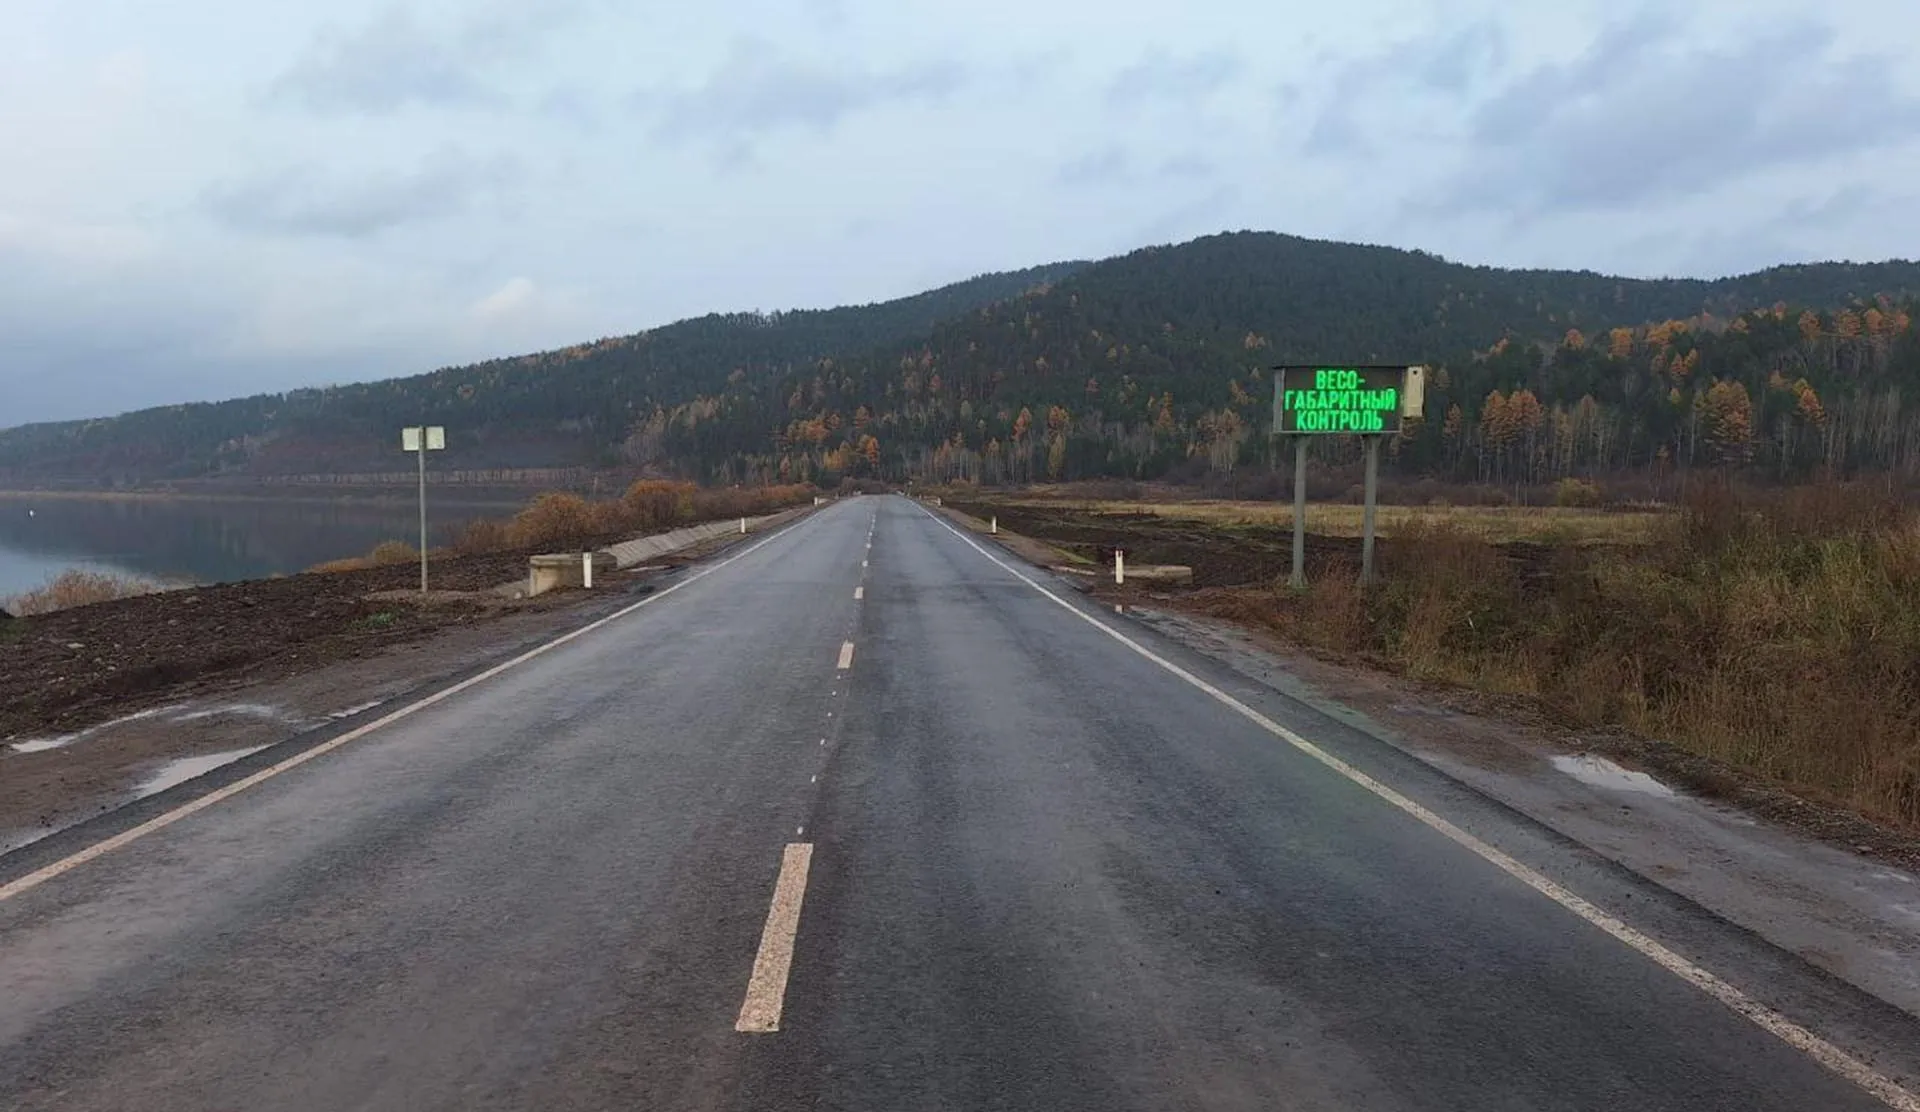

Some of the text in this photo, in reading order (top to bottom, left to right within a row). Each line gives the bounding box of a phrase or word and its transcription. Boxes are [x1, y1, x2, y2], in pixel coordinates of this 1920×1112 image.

[1316, 370, 1366, 389] ВЕСО-
[1284, 388, 1396, 410] ГАБАРИТНЫЙ
[1296, 409, 1383, 430] КОНТРОЛЬ
